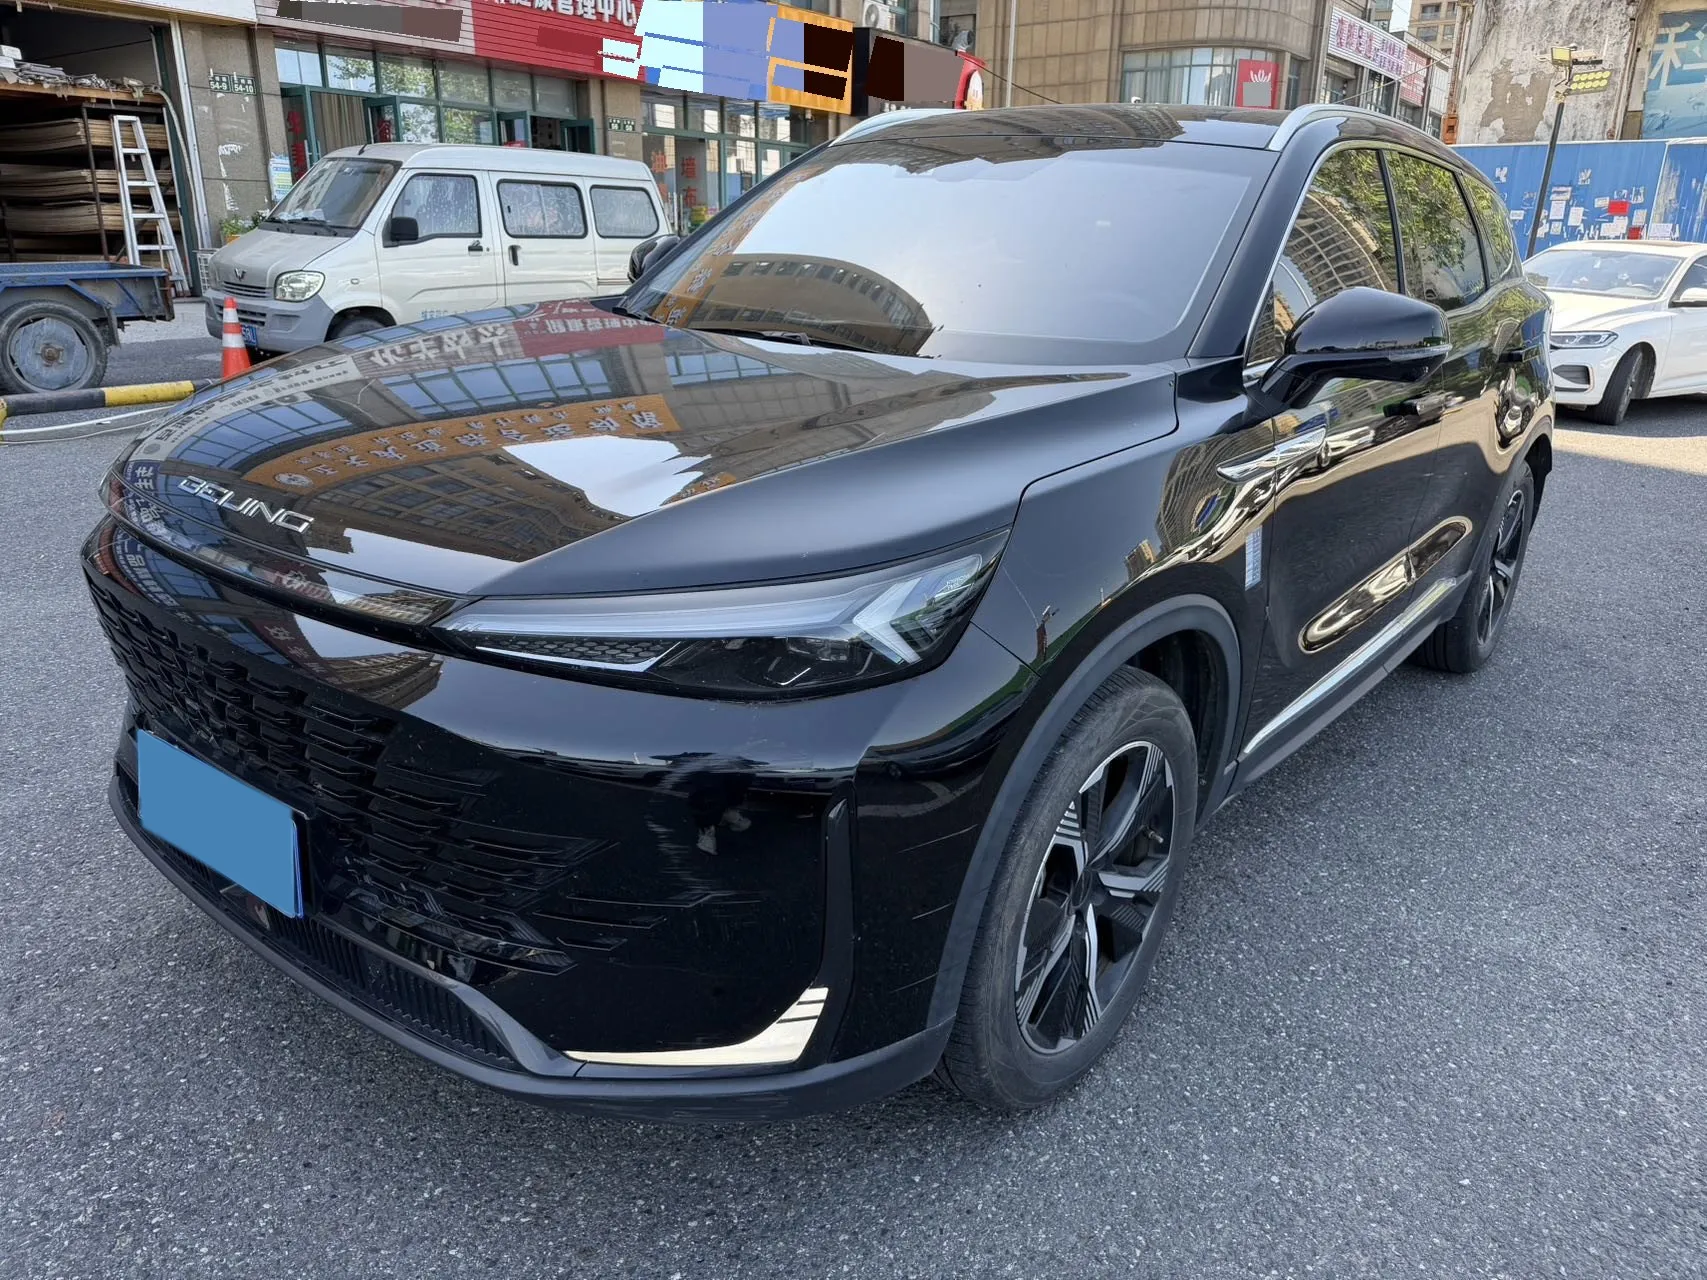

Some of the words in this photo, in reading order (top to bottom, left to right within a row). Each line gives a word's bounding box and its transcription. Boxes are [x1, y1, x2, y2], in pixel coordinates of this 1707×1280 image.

[210, 82, 228, 91] 54-9
[234, 84, 254, 93] 54-10
[178, 475, 315, 534] BEIJING
